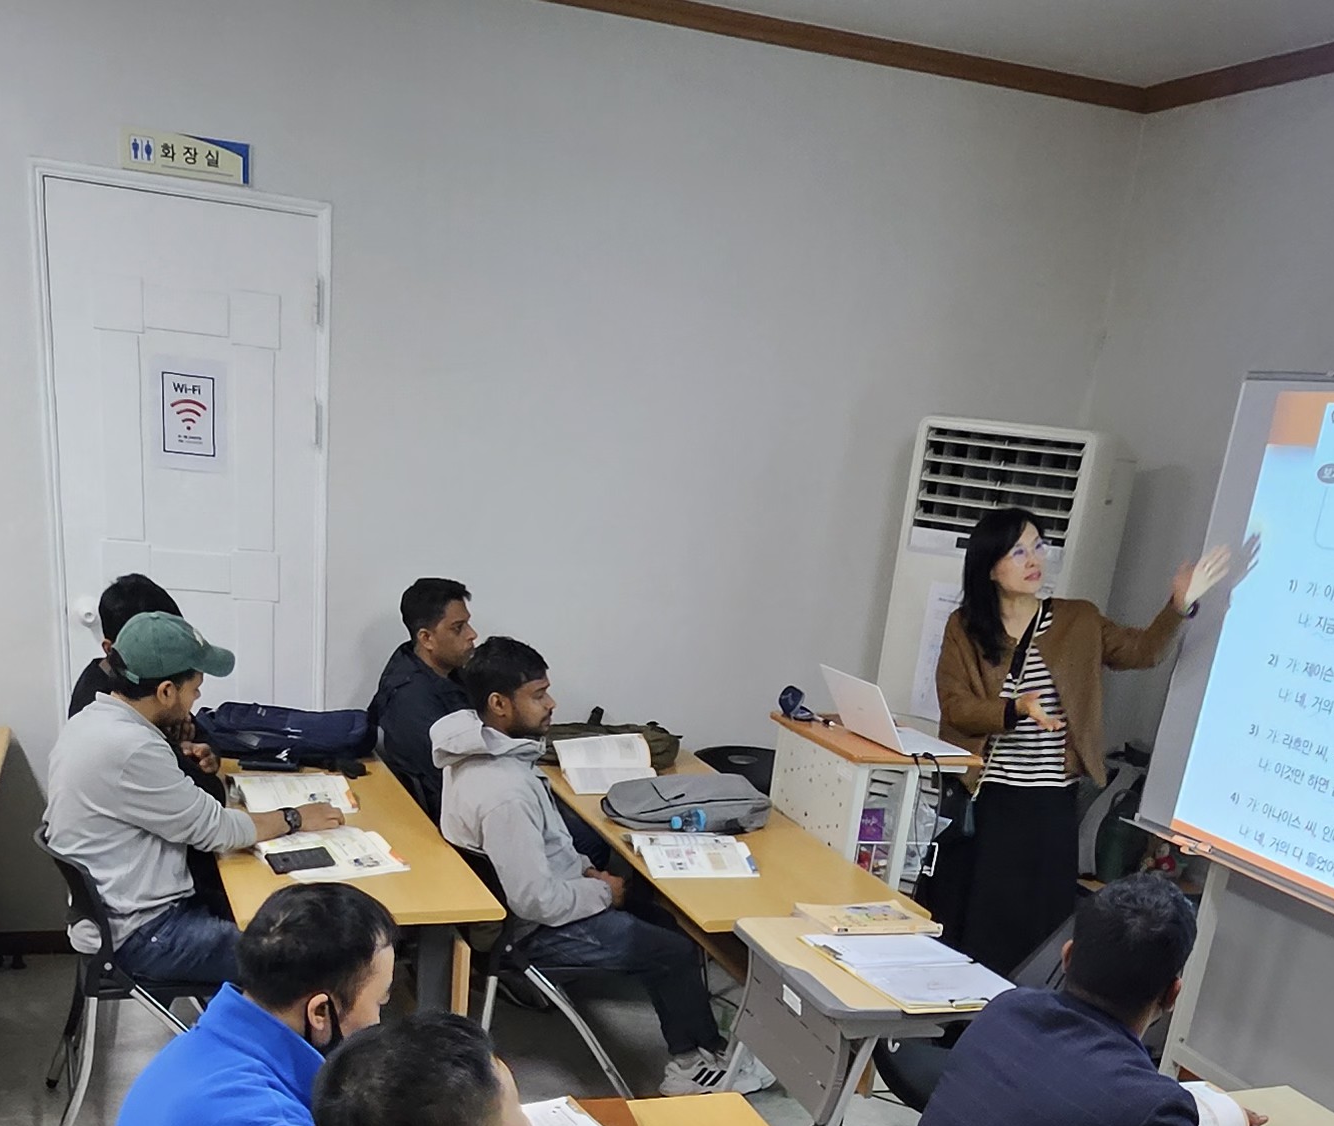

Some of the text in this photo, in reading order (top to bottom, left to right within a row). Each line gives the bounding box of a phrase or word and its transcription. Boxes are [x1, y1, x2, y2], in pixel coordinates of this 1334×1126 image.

[160, 142, 221, 168] 화장실
[172, 382, 202, 395] Wi-Fi
[1288, 579, 1298, 593] 1)
[1267, 653, 1278, 668] 2)
[1303, 662, 1334, 683] 제이슨
[1294, 691, 1307, 711] 네,
[1311, 695, 1334, 715] 거의
[1249, 723, 1259, 737] 3)
[1274, 762, 1306, 785] 이것만
[1307, 774, 1330, 795] 하면
[1230, 792, 1240, 806] 4)
[1269, 836, 1291, 857] 거의
[1292, 845, 1304, 862] 다
